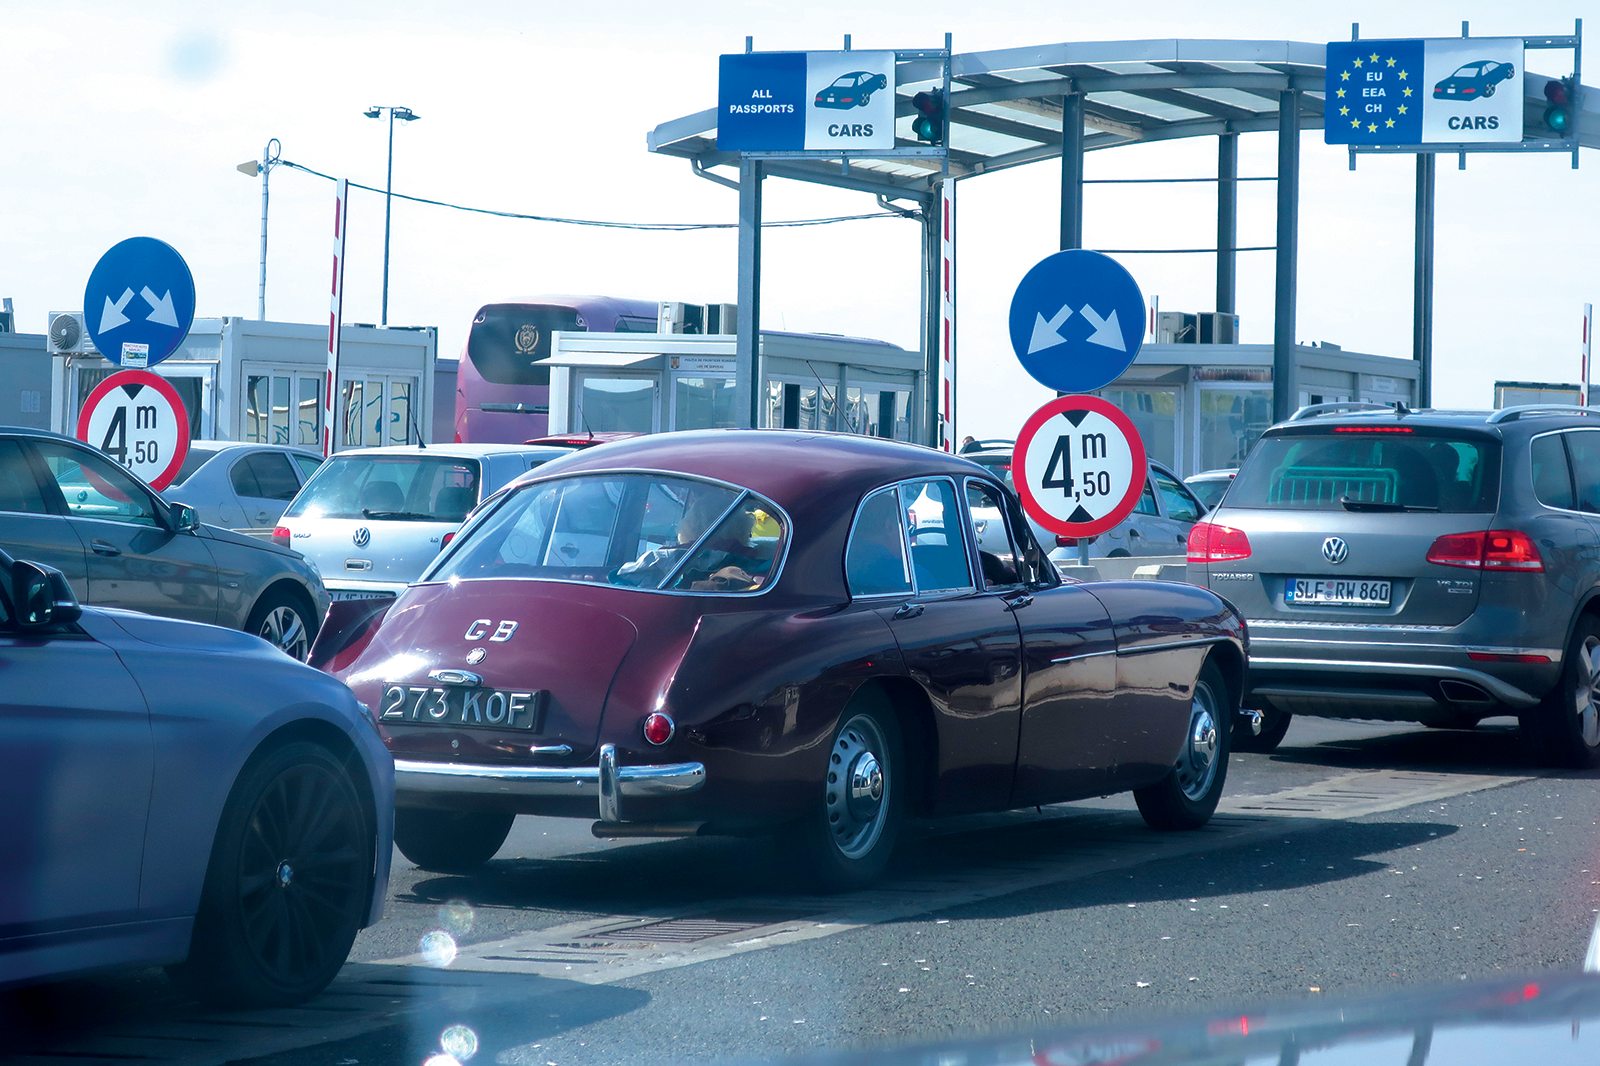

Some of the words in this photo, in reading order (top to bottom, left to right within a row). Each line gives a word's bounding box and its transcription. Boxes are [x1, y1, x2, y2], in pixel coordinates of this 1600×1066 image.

[1366, 72, 1383, 81] EU
[751, 89, 773, 98] ALL
[1362, 88, 1386, 97] EEA
[729, 104, 795, 114] PASSPORTS
[1365, 104, 1382, 113] CH
[1448, 115, 1500, 130] CARS
[828, 124, 874, 137] CARS
[136, 405, 157, 430] m
[1081, 433, 1107, 459] m
[1295, 580, 1325, 599] SLF
[1335, 581, 1356, 600] RW
[1360, 582, 1389, 601] 860
[464, 619, 519, 642] GB
[382, 686, 449, 720] 273
[461, 691, 532, 725] KOF
